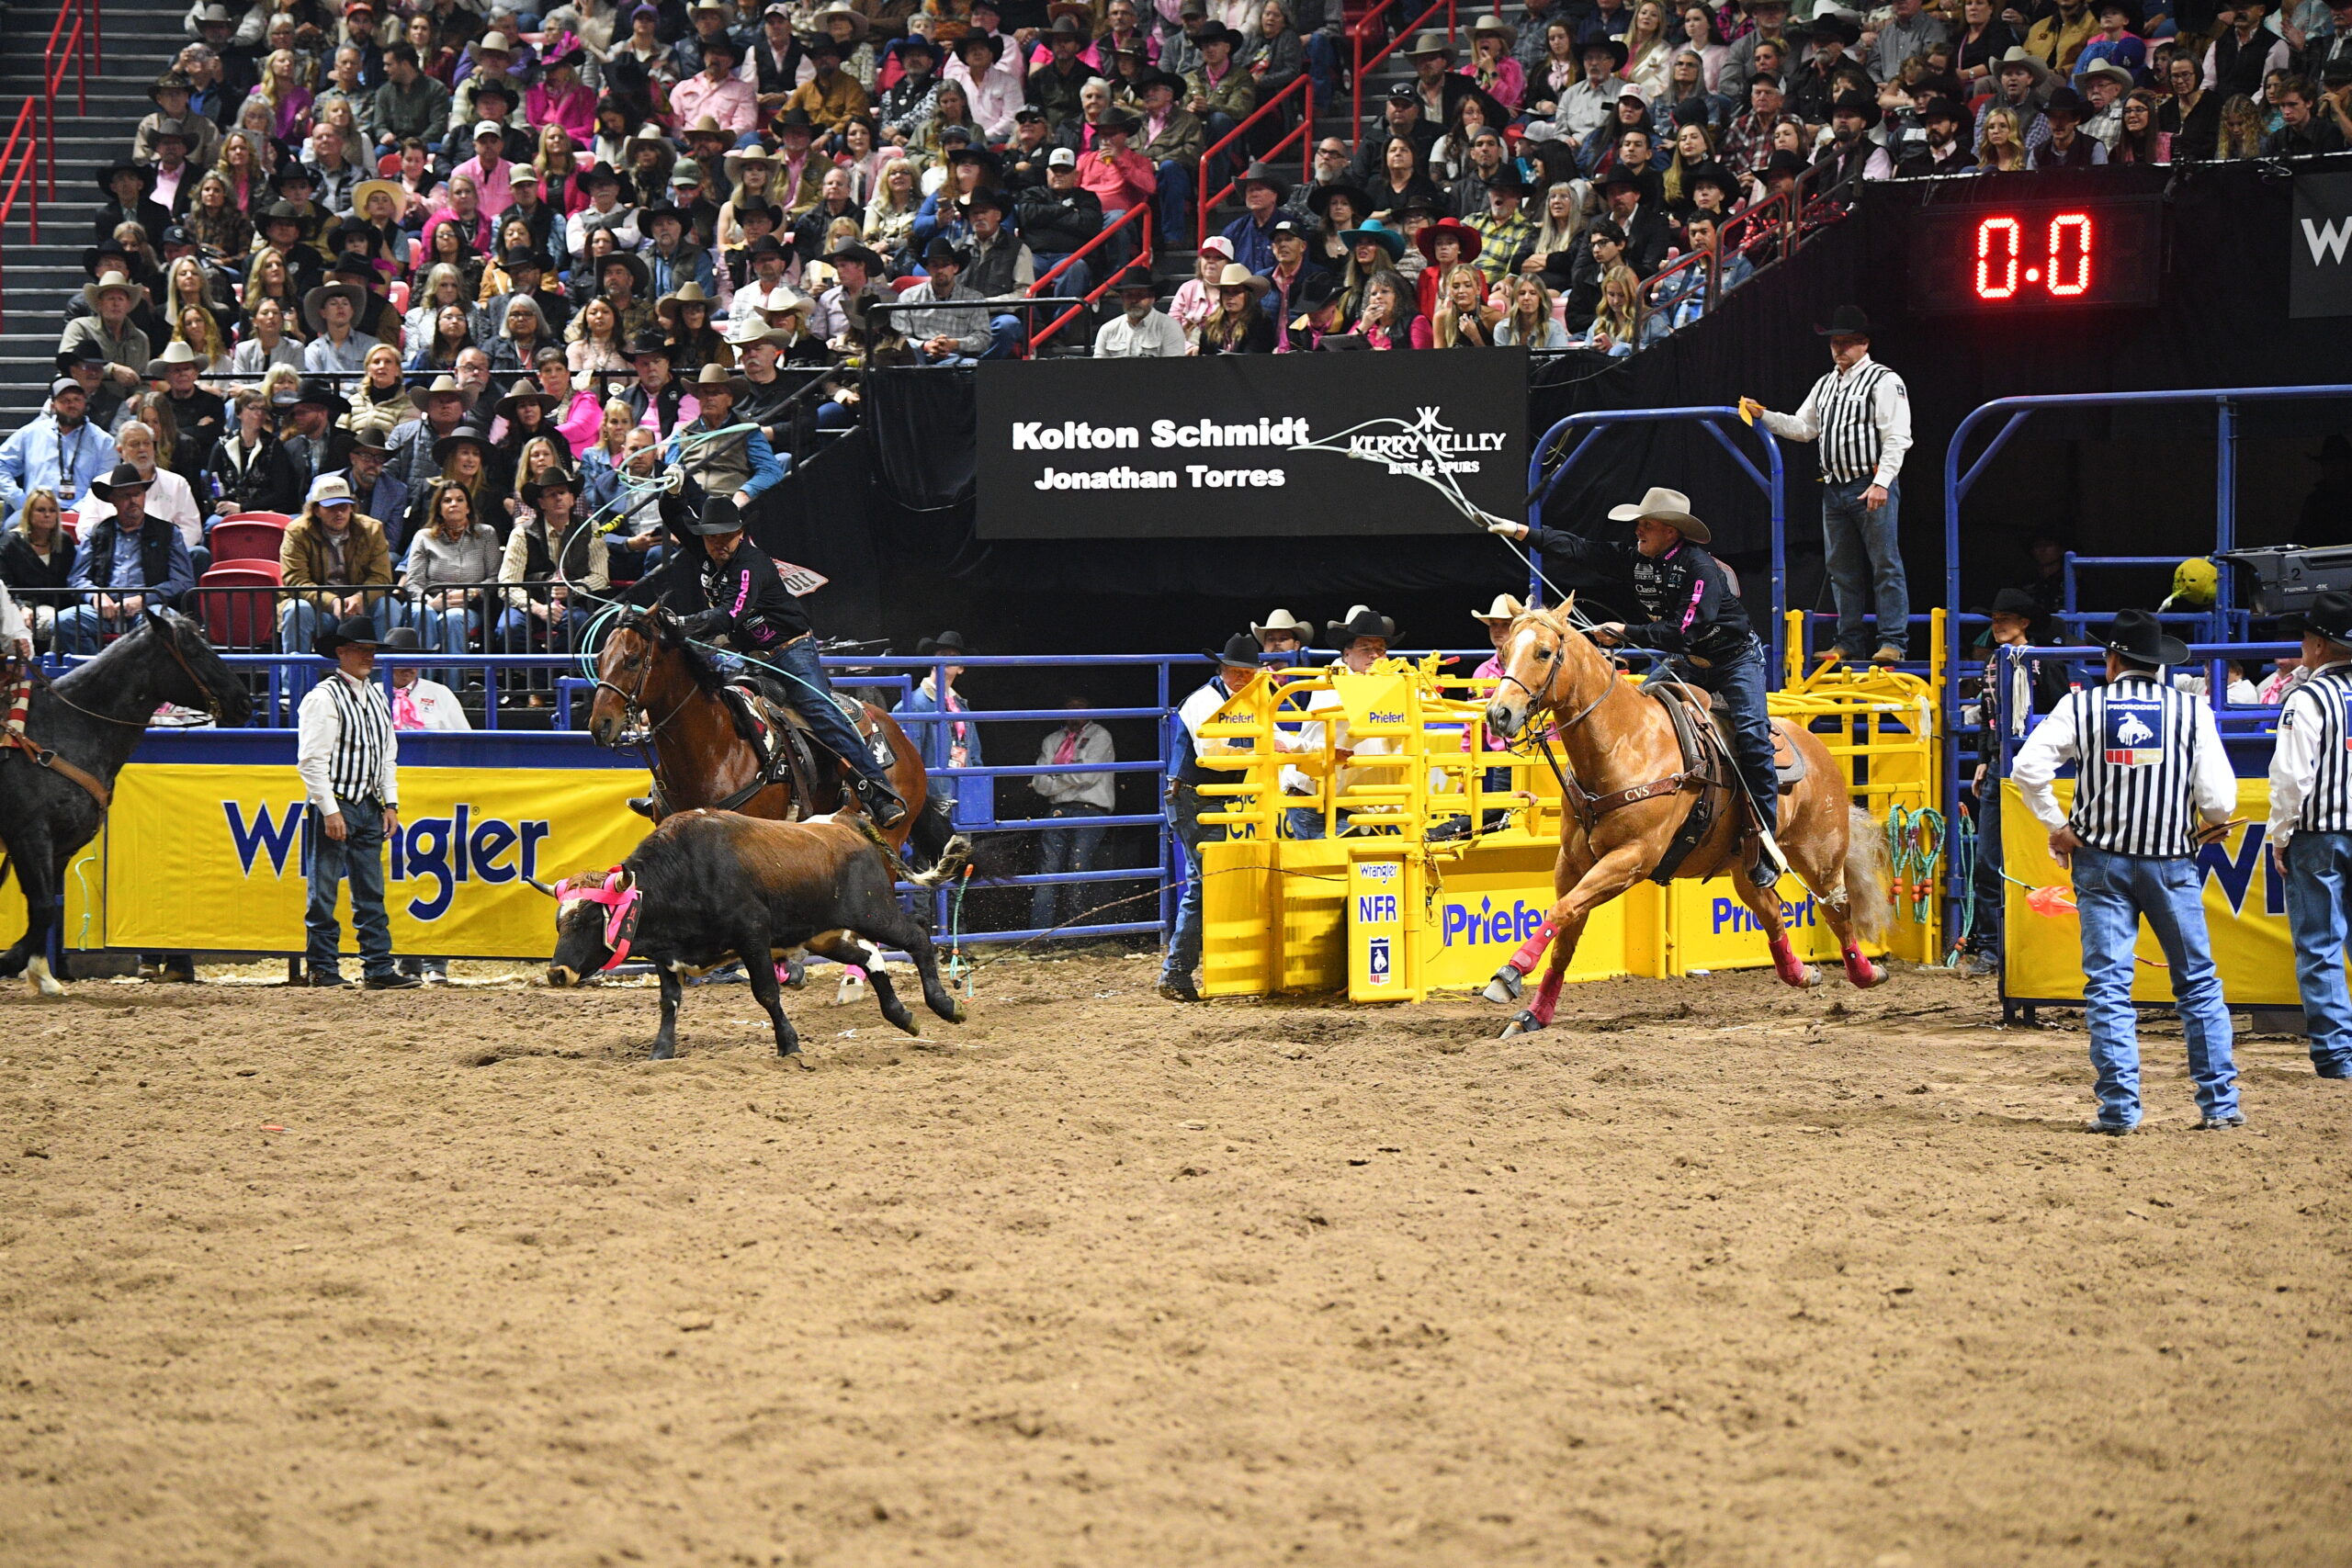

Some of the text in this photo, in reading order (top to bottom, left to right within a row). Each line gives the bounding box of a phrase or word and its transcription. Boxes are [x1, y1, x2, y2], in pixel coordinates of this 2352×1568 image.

[1976, 213, 2091, 299] 0.0
[1012, 416, 1309, 450] Kolton Schmidt
[1350, 432, 1507, 459] KERRY KELLEY
[1034, 465, 1286, 491] Jonathan Torres
[1420, 459, 1436, 477] &
[1438, 460, 1480, 474] SPURS
[2291, 568, 2301, 581] 2
[1218, 711, 1254, 724] Priefert
[1369, 710, 1405, 723] Priefert
[1624, 785, 1650, 801] CVS
[221, 800, 549, 922] Wngler
[1359, 863, 1397, 884] Wrangler
[1359, 896, 1396, 922] NFR
[1442, 895, 1548, 947] Priefe
